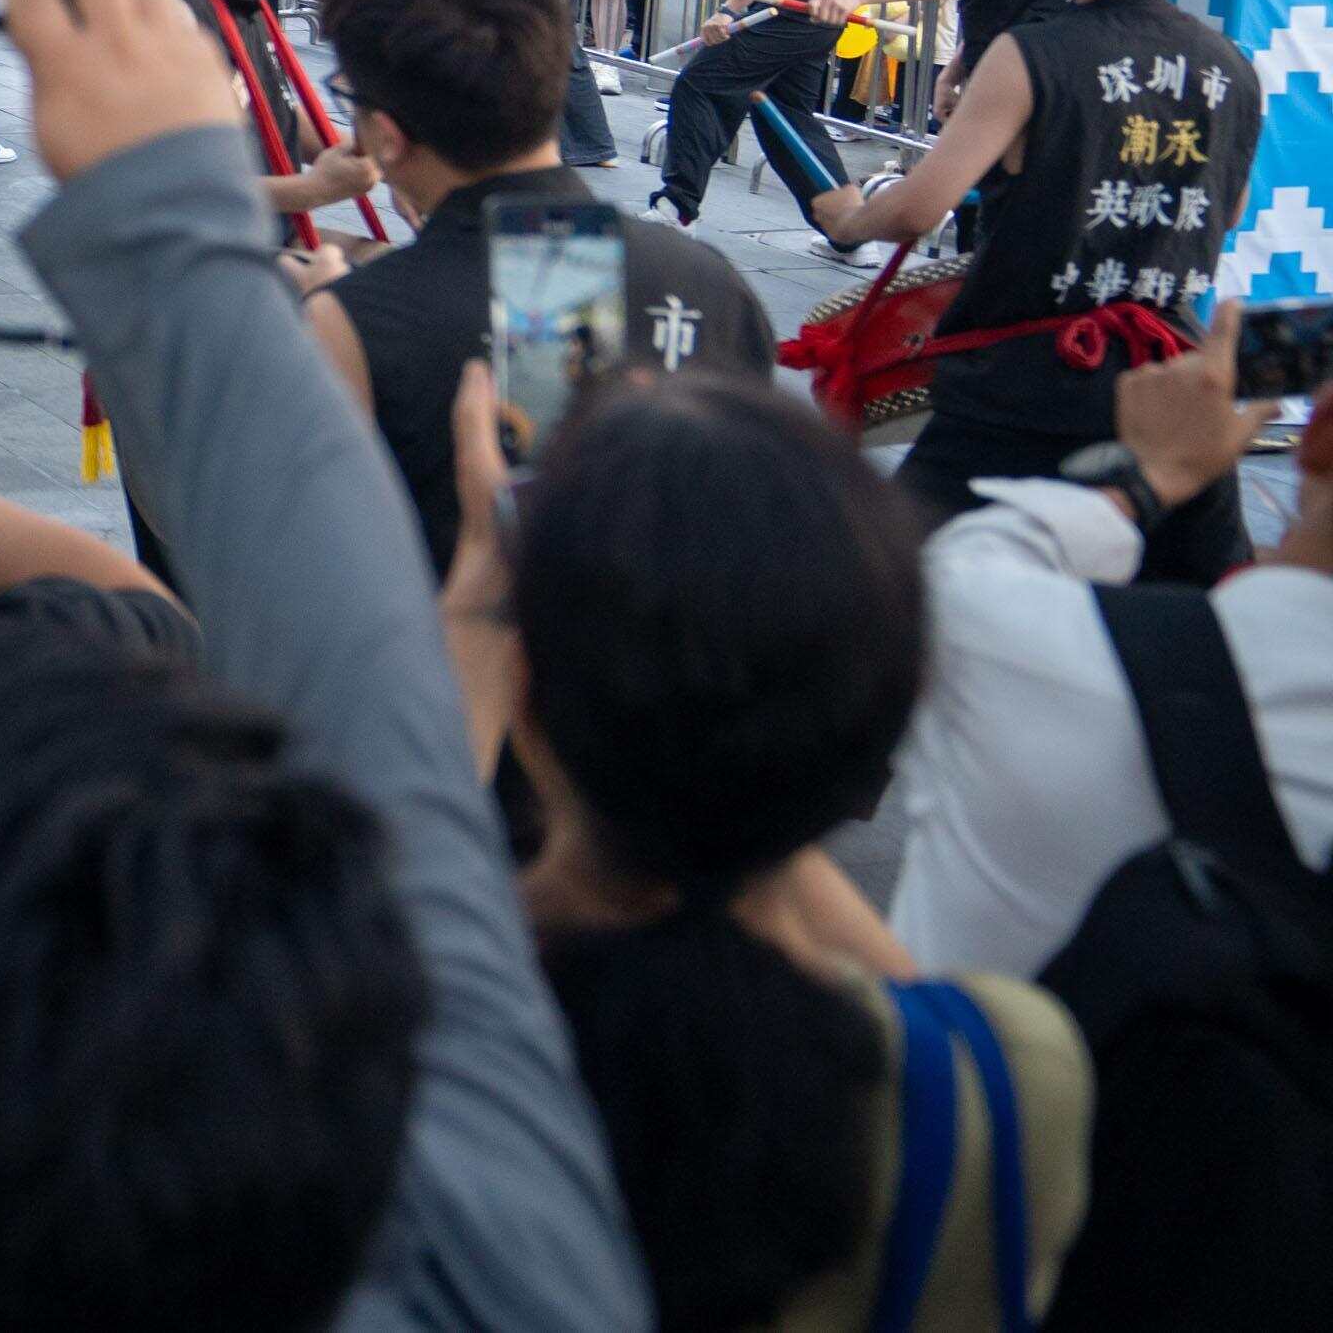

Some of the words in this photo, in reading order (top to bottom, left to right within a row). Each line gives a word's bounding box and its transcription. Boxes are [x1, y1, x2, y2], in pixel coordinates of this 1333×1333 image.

[1097, 53, 1232, 110] 深圳市
[1118, 114, 1210, 166] 潮承
[645, 293, 703, 374] 市
